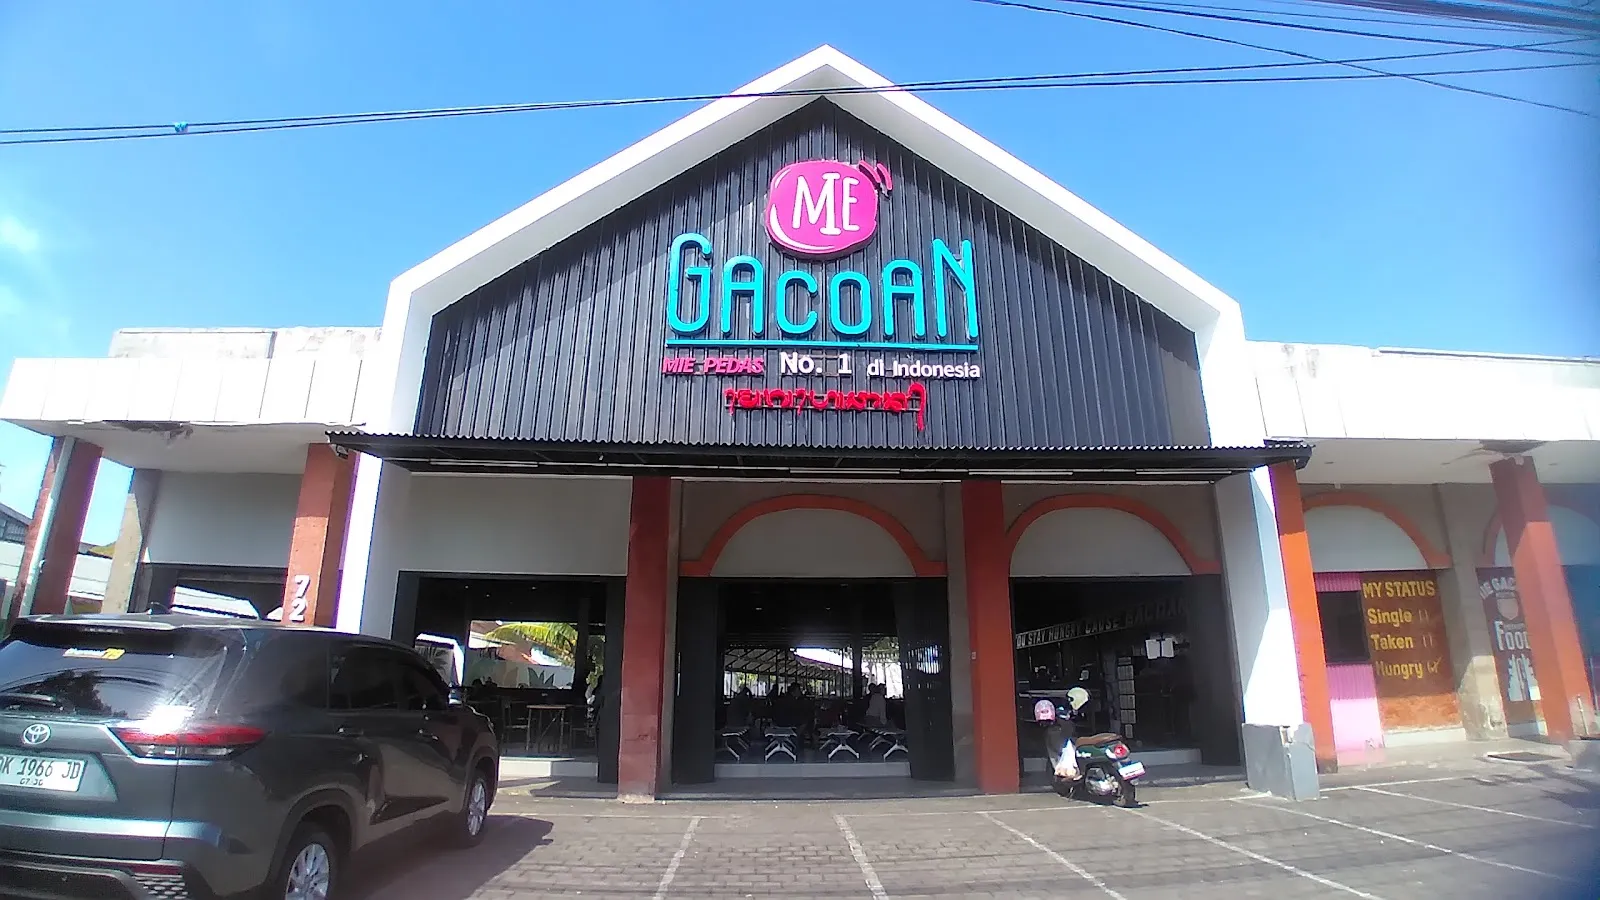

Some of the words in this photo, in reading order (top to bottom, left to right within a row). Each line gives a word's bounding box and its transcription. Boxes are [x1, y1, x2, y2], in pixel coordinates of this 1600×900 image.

[667, 233, 978, 340] GACOAN
[661, 357, 696, 375] MIE
[703, 358, 765, 375] PEDAS
[779, 352, 823, 375] No.
[837, 353, 852, 375] 1
[866, 359, 885, 377] di
[891, 360, 981, 379] Indonesia
[1362, 582, 1383, 599] MY
[1385, 579, 1436, 599] STATUS
[1367, 607, 1413, 628] Single
[1027, 631, 1046, 646] STAY
[1370, 634, 1414, 651] Taken
[1375, 660, 1424, 680] Hungry
[17, 758, 54, 777] 1966
[62, 762, 81, 779] JD
